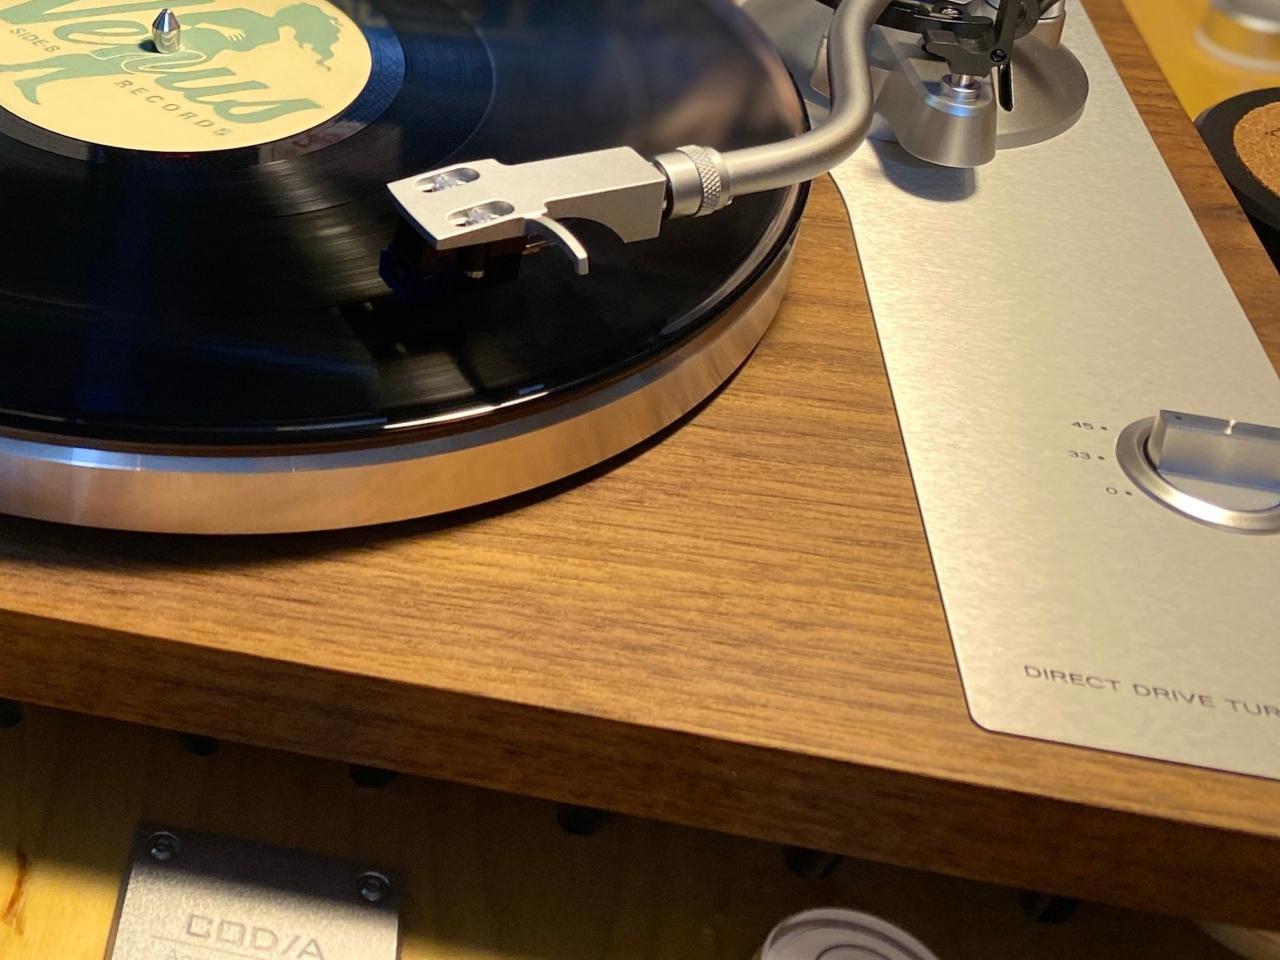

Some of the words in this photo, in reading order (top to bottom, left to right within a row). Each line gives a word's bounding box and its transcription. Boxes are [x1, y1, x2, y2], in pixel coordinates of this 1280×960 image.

[114, 79, 233, 136] RECORDS
[1071, 421, 1094, 431] 45
[1067, 449, 1091, 460] 33
[1023, 664, 1121, 692] DIRECT
[1132, 683, 1217, 709] DRIVE
